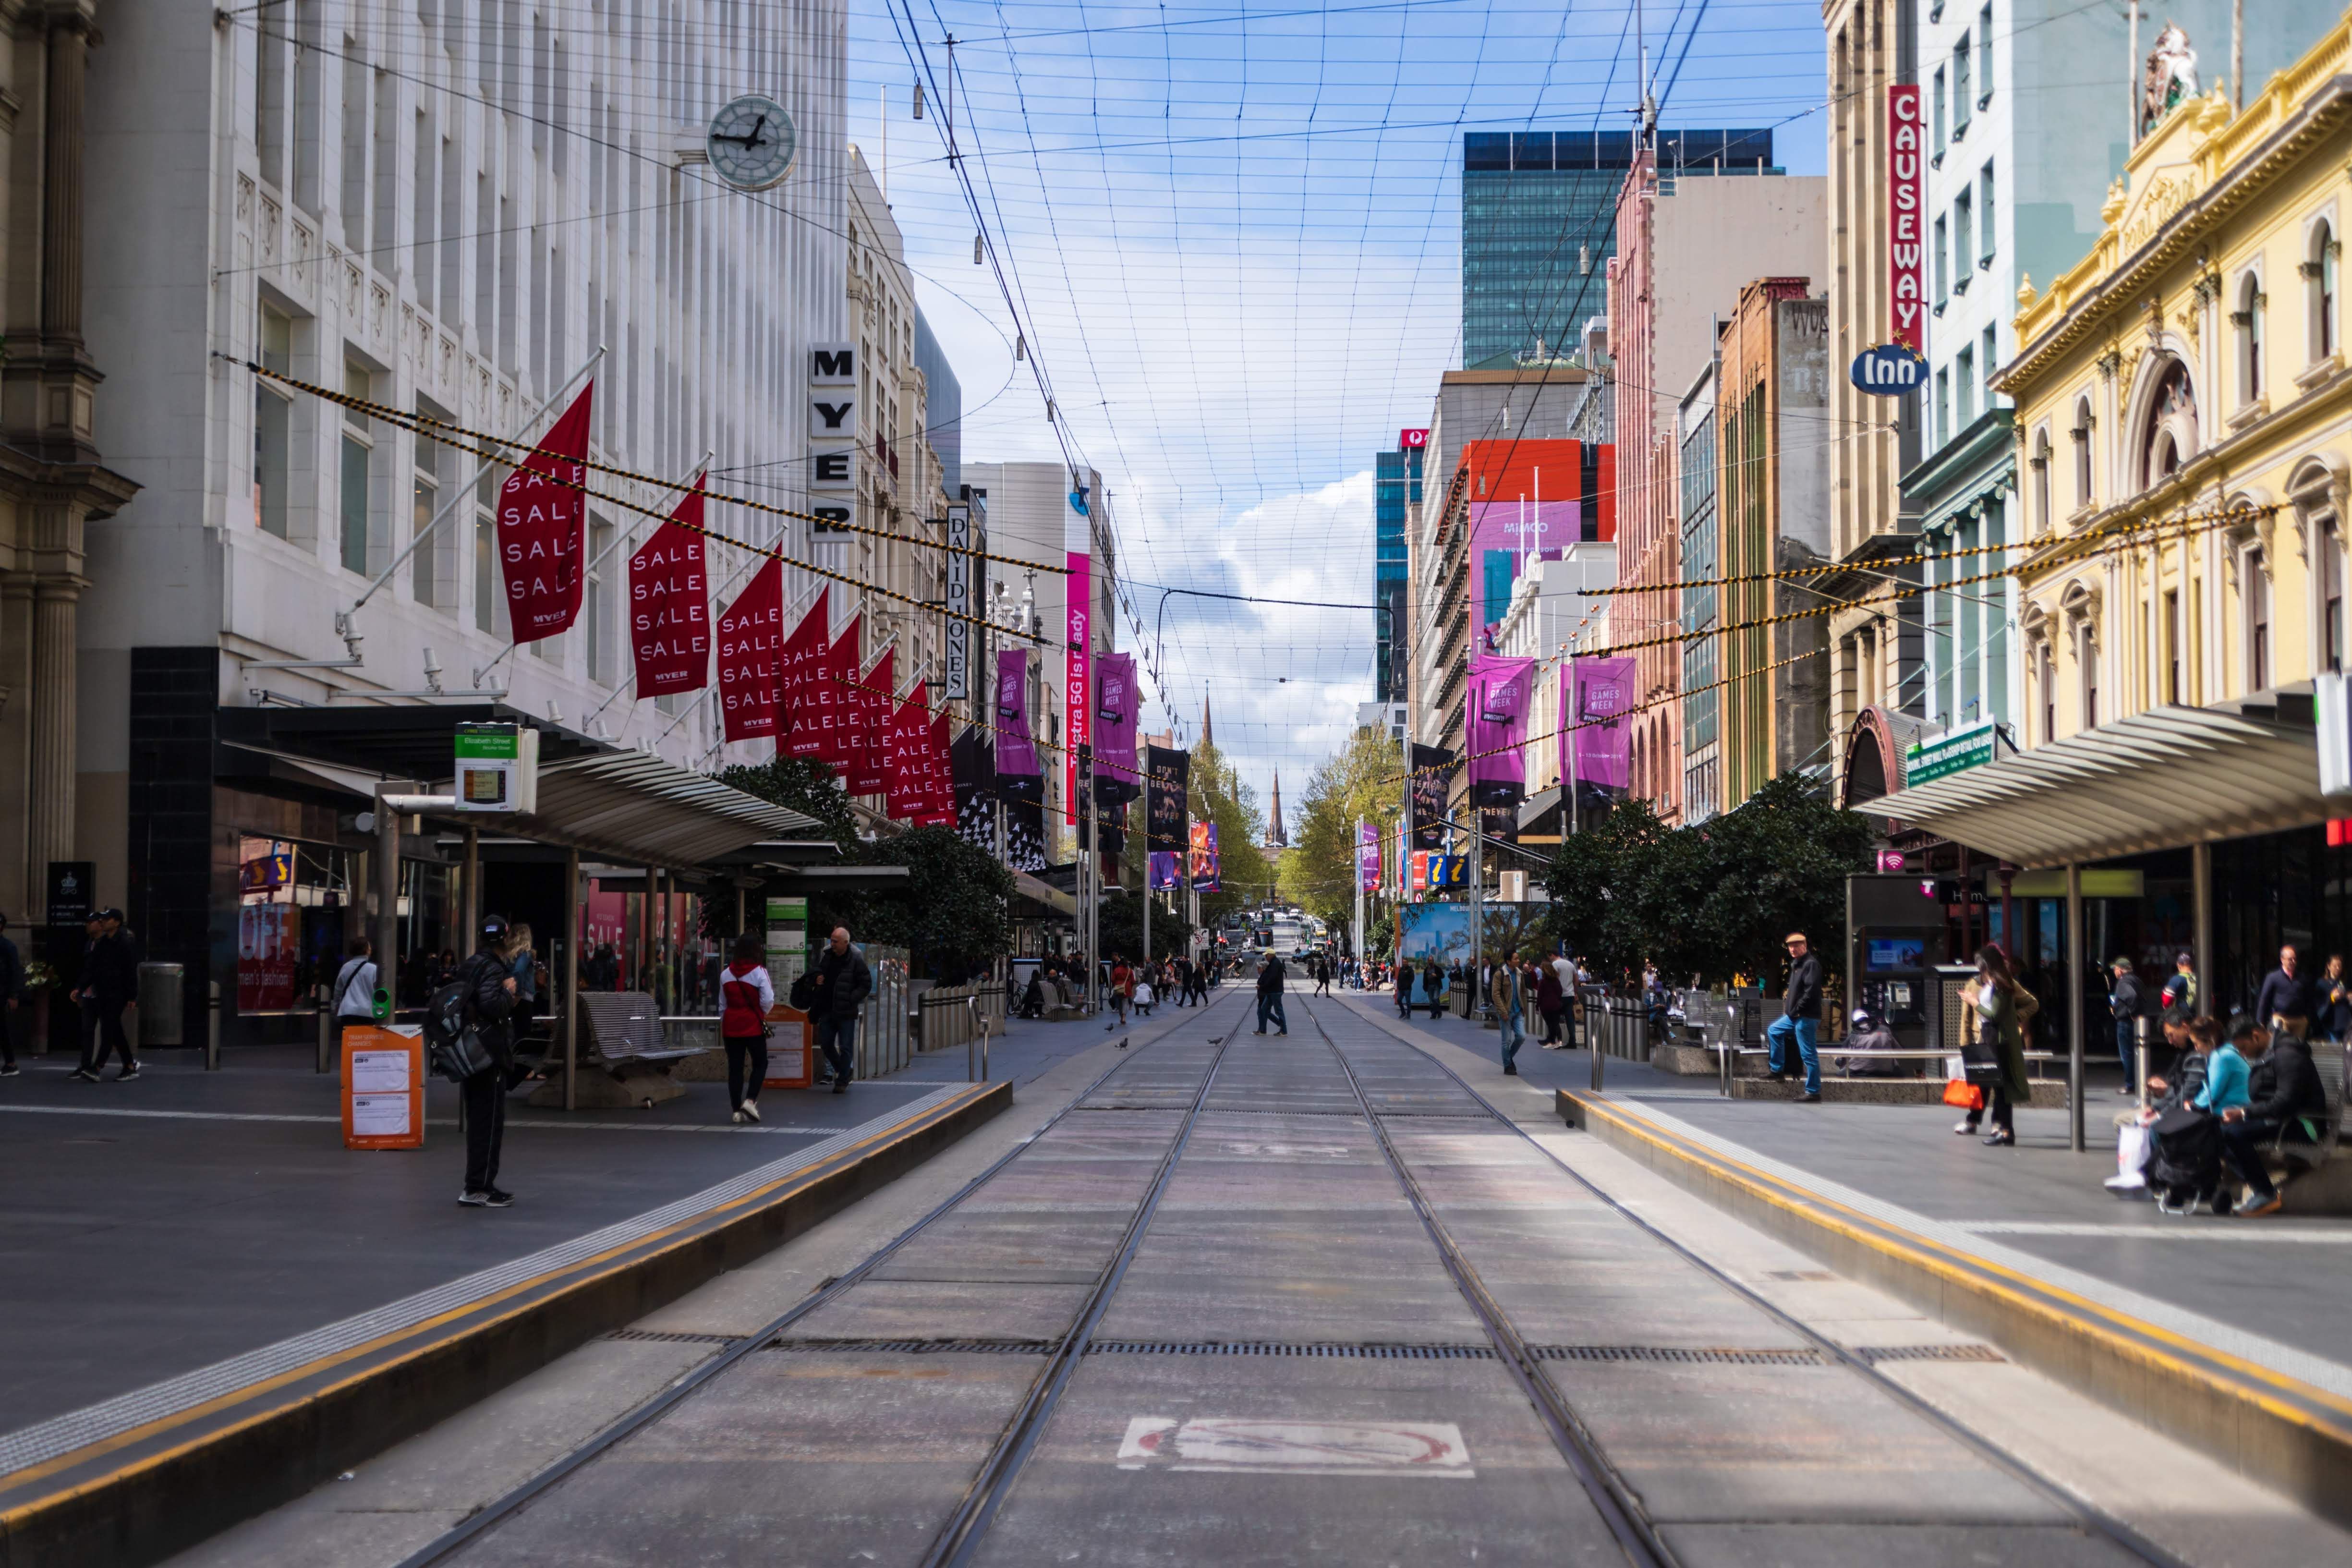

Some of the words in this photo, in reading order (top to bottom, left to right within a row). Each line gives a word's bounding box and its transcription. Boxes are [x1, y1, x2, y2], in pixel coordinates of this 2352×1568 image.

[1893, 95, 1919, 328] CAUSEWAY
[1865, 354, 1916, 384] Inn
[813, 351, 853, 533] MYER
[634, 545, 700, 571] SALE
[950, 519, 965, 599] DAVID
[634, 575, 701, 600] SALE
[533, 608, 567, 623] MYER
[723, 608, 778, 632] SALE
[1070, 609, 1086, 659] rady
[640, 636, 706, 661] SALE
[723, 635, 779, 656] SALE
[949, 605, 964, 690] JONES
[655, 670, 688, 681] MYER
[723, 662, 781, 682] SALE
[1071, 663, 1082, 678] is
[726, 689, 782, 709] SALE
[1071, 681, 1082, 705] 5G
[1105, 684, 1123, 696] GAMES
[1491, 688, 1517, 699] GAMES
[1592, 689, 1620, 701] GAMES
[786, 692, 831, 709] ALE
[1105, 695, 1120, 706] WEEK
[1491, 697, 1511, 709] WEEK
[1591, 700, 1614, 711] WEEK
[743, 718, 772, 727] MYER
[793, 742, 820, 751] MYER
[1363, 851, 1378, 860] Show
